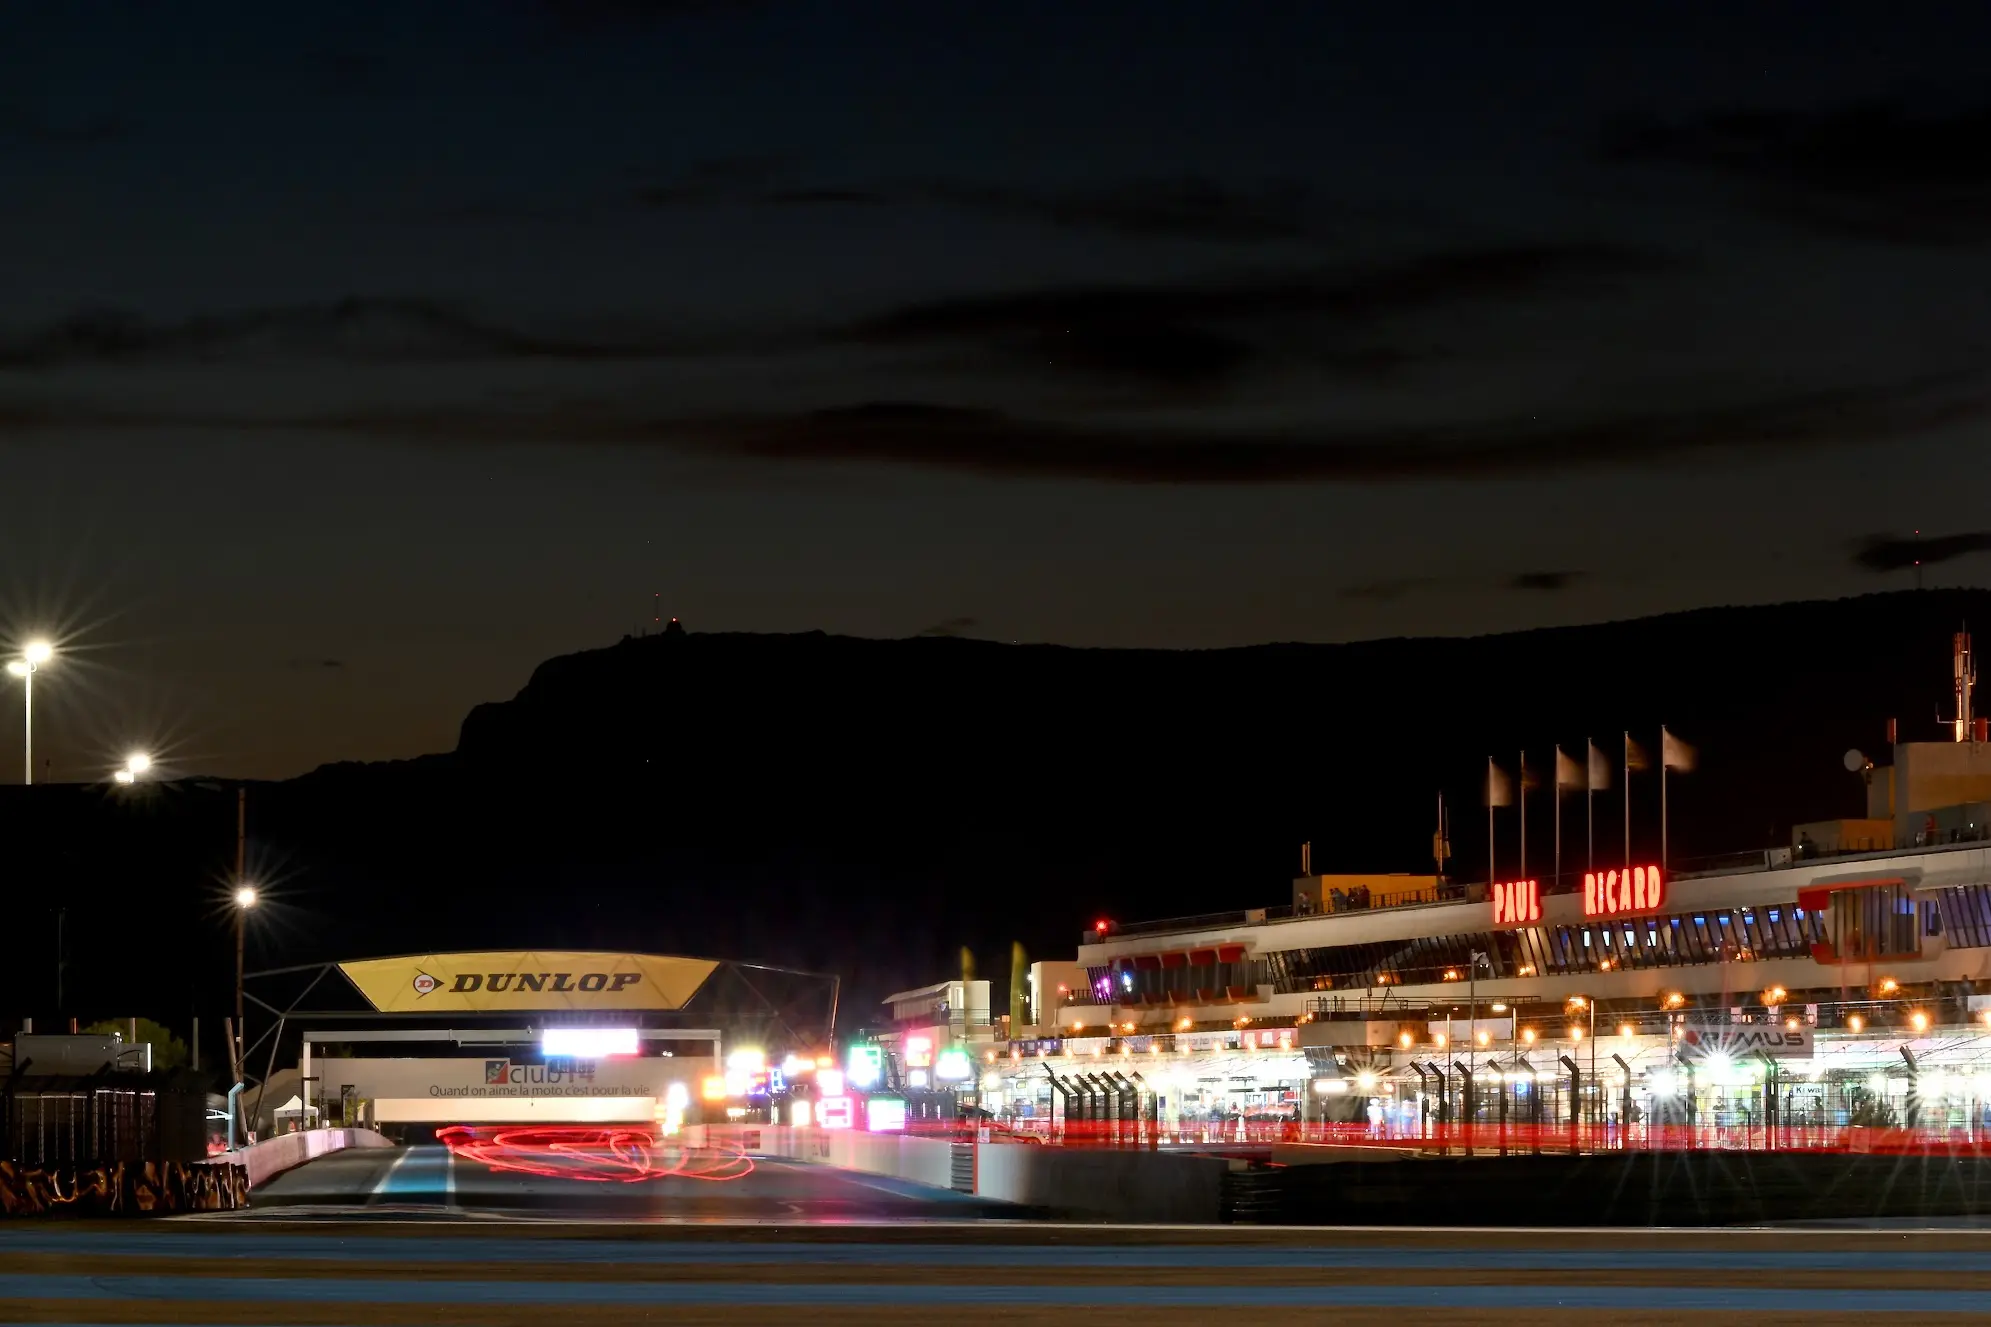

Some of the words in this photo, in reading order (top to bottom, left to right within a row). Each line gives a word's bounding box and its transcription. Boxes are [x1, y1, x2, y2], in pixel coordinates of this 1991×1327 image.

[1493, 880, 1539, 923] PAUL
[1585, 865, 1661, 915] RICARD
[448, 973, 642, 993] DUNLOP
[429, 1085, 469, 1097] Quand
[471, 1087, 487, 1096] on
[489, 1085, 517, 1096] aime
[519, 1085, 530, 1096] la
[532, 1086, 563, 1096] moto
[565, 1084, 589, 1096] c'est
[592, 1086, 620, 1098] pour
[621, 1084, 632, 1096] la
[633, 1084, 651, 1096] vie
